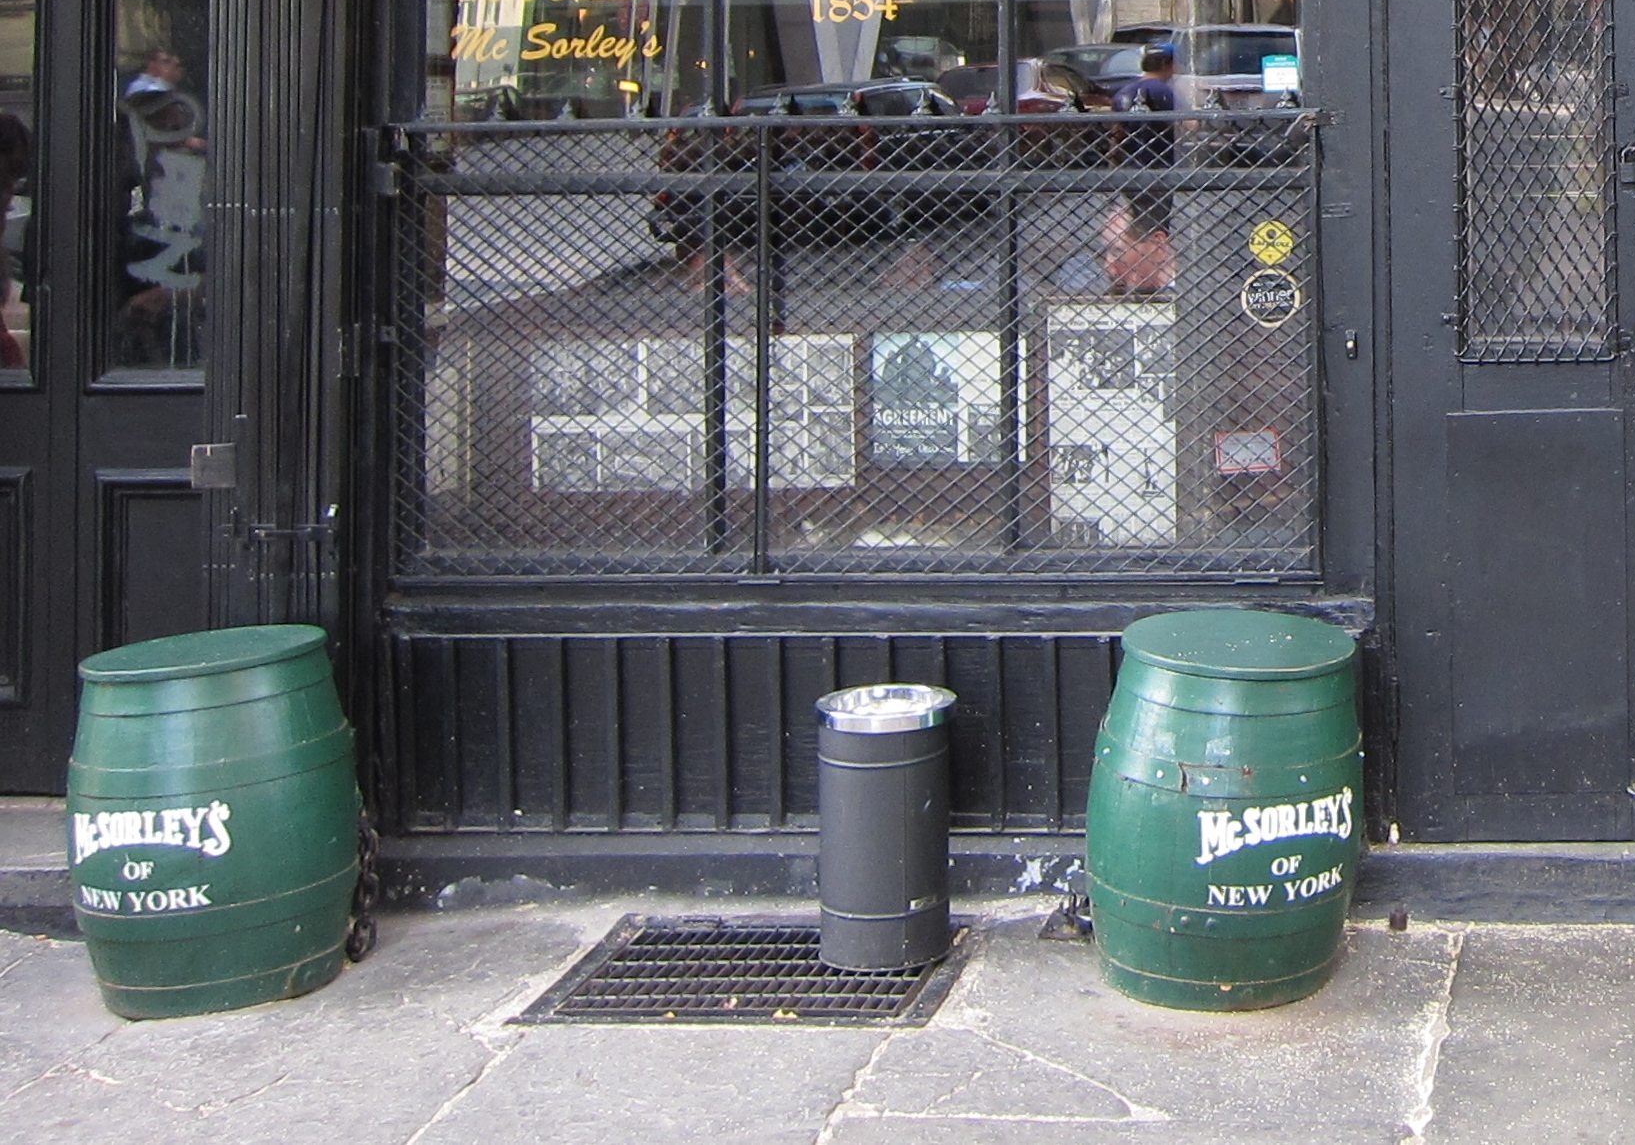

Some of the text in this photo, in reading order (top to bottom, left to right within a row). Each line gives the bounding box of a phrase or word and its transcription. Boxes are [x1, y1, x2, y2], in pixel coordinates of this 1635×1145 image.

[450, 21, 662, 70] Mc Sorley's
[122, 861, 155, 881] OF
[1271, 855, 1303, 877] OF
[81, 884, 213, 913] NEW YORK
[1207, 863, 1344, 907] NEW YORK
